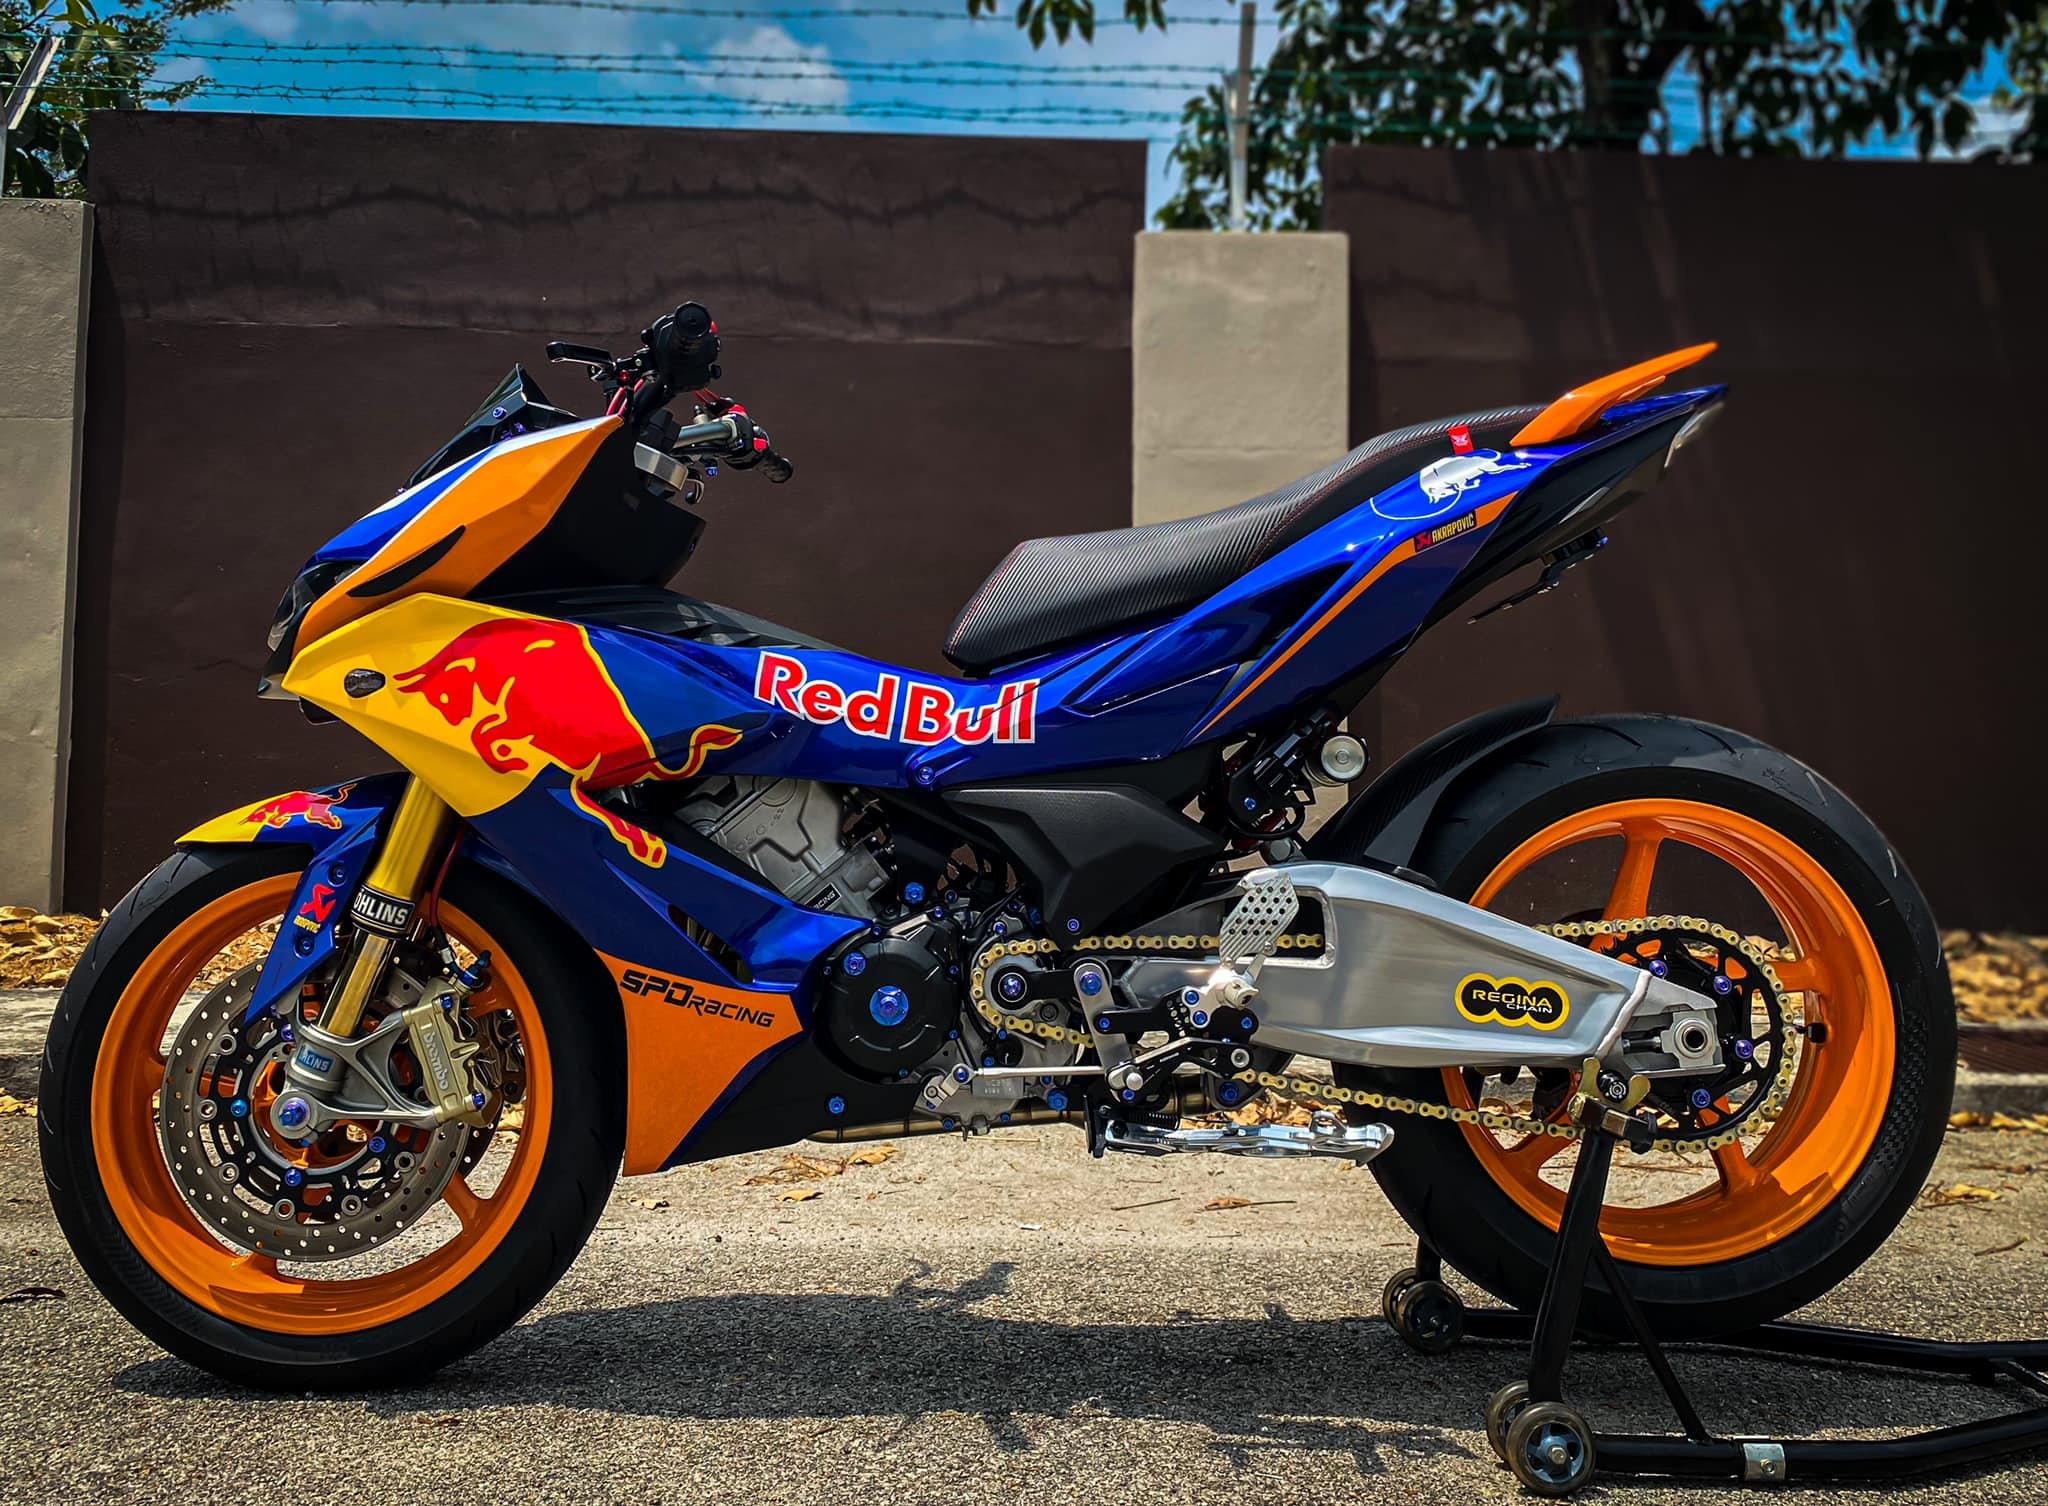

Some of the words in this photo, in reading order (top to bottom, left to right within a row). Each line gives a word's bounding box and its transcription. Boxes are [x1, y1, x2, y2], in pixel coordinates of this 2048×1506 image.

[755, 650, 900, 740] Red
[900, 678, 1040, 746] Bull
[1472, 989, 1552, 1009] REGINA
[1506, 1002, 1553, 1014] CHAIN
